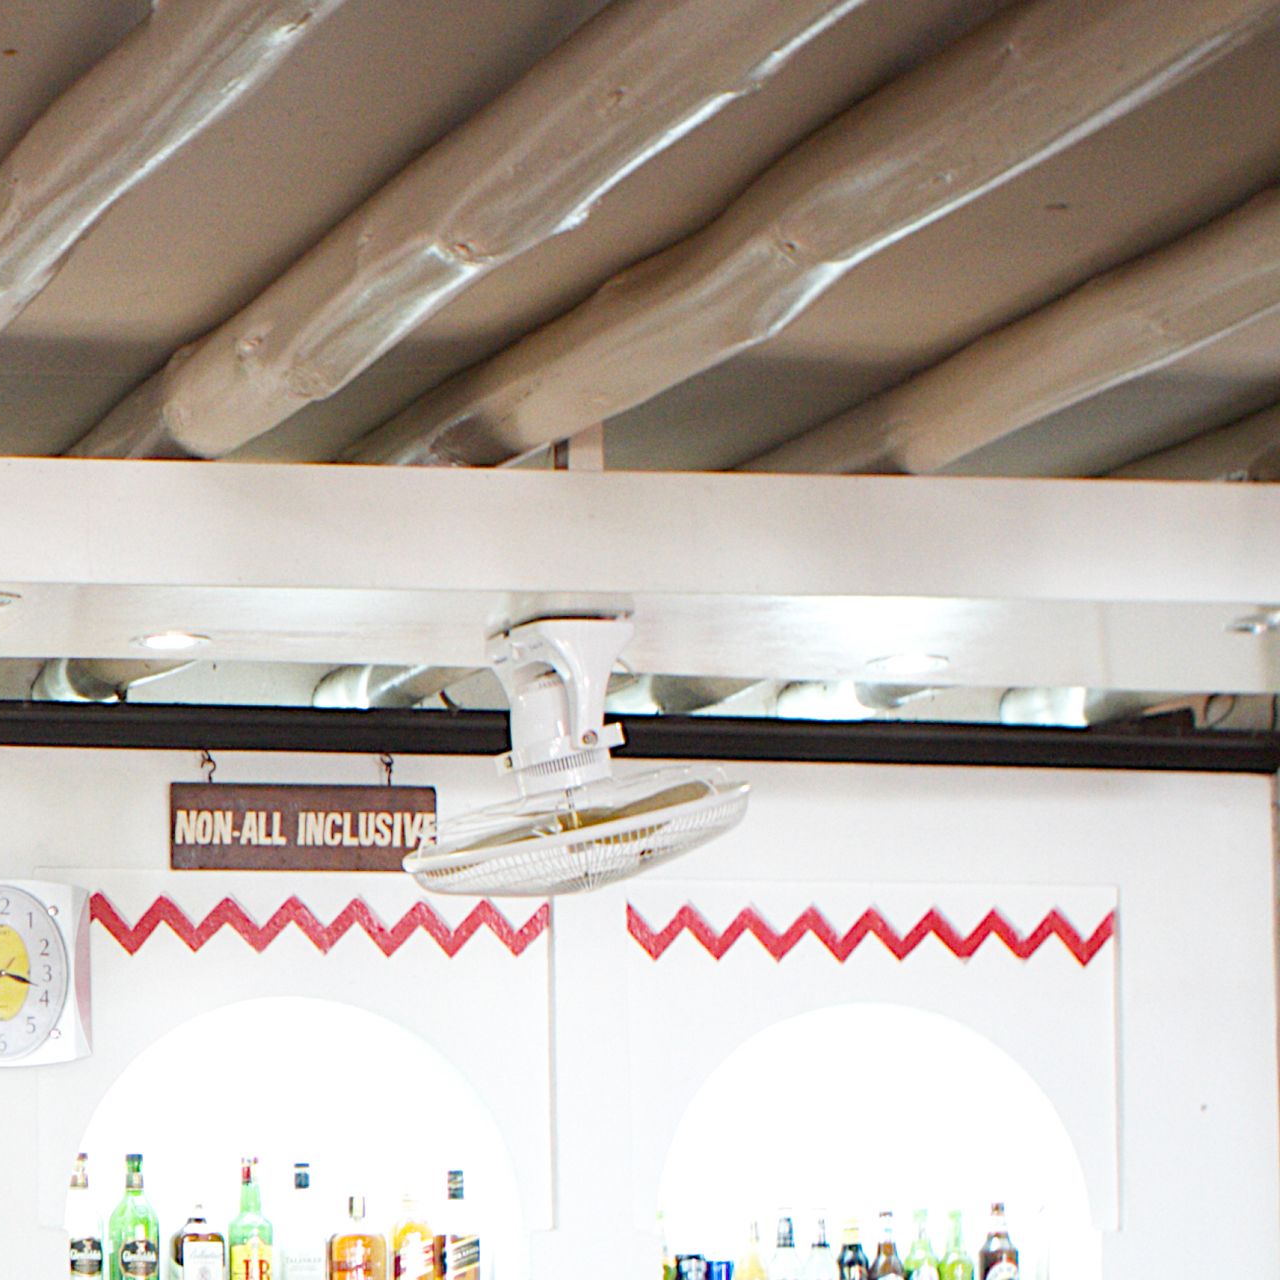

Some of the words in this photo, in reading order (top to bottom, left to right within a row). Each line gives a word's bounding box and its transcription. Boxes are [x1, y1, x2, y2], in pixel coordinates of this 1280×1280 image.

[174, 809, 287, 845] NON-ALL
[296, 811, 437, 847] INCLUSIVE
[26, 911, 33, 929] 1
[39, 938, 50, 956] 2
[42, 965, 53, 983] 3
[39, 989, 50, 1008] 4
[26, 1016, 37, 1034] 5
